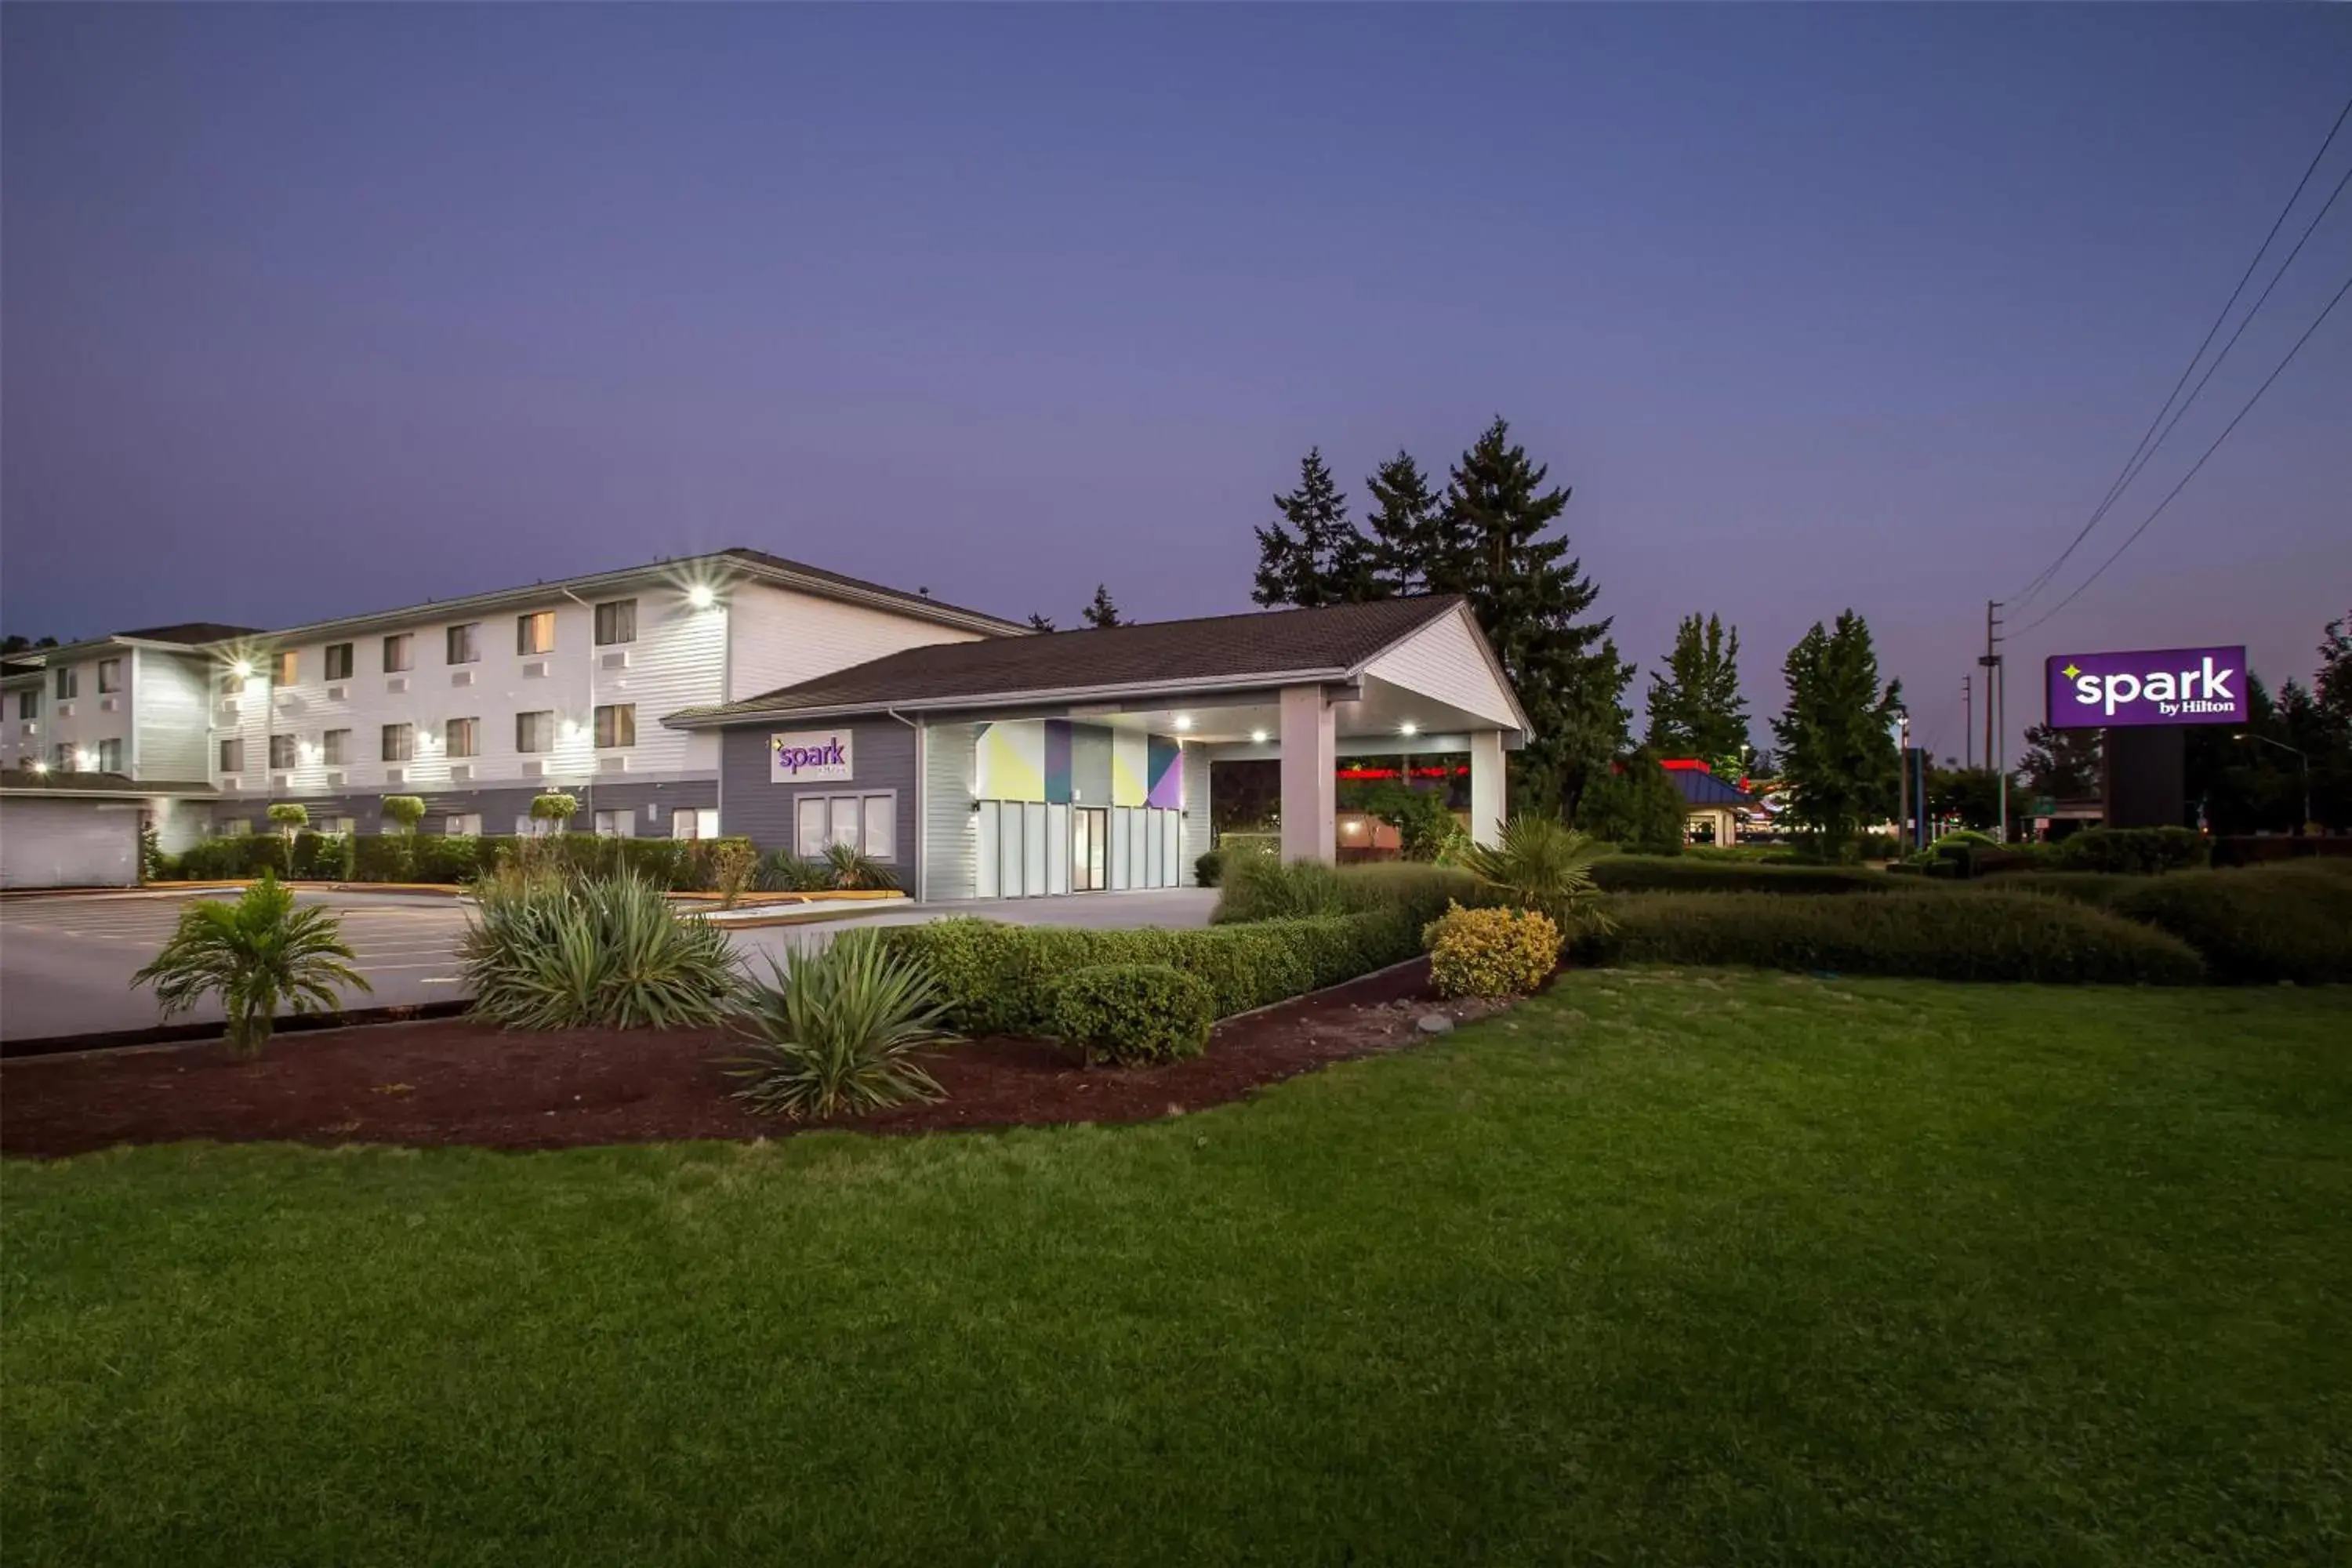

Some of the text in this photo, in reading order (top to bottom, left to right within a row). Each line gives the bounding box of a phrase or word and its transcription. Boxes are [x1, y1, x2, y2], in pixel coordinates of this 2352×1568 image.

[2076, 657, 2234, 715] spark
[2158, 700, 2234, 717] by Hilton
[779, 736, 845, 775] spark
